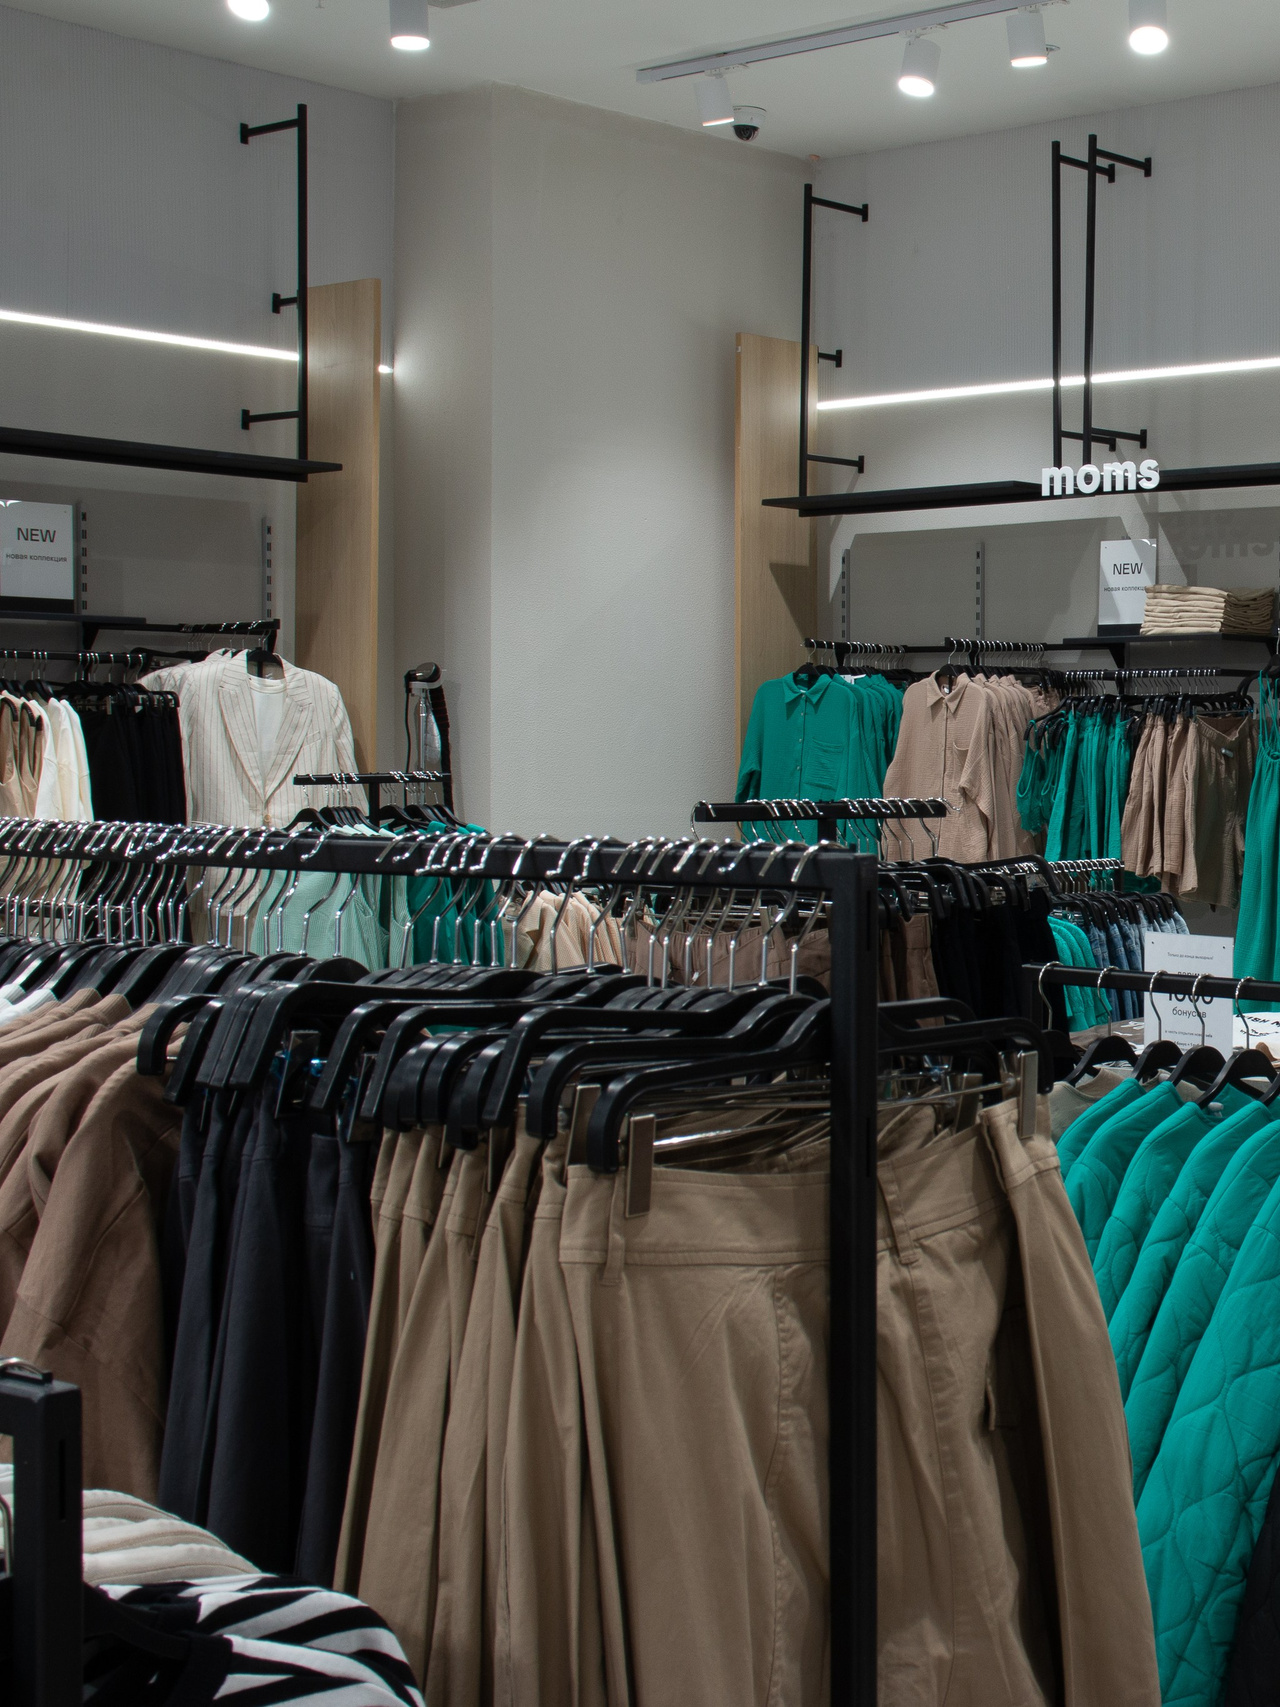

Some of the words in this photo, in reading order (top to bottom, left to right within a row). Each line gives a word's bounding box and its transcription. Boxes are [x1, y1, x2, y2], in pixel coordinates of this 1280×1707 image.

[1041, 459, 1160, 497] moms
[17, 527, 56, 543] NEW
[1112, 562, 1143, 575] NEW
